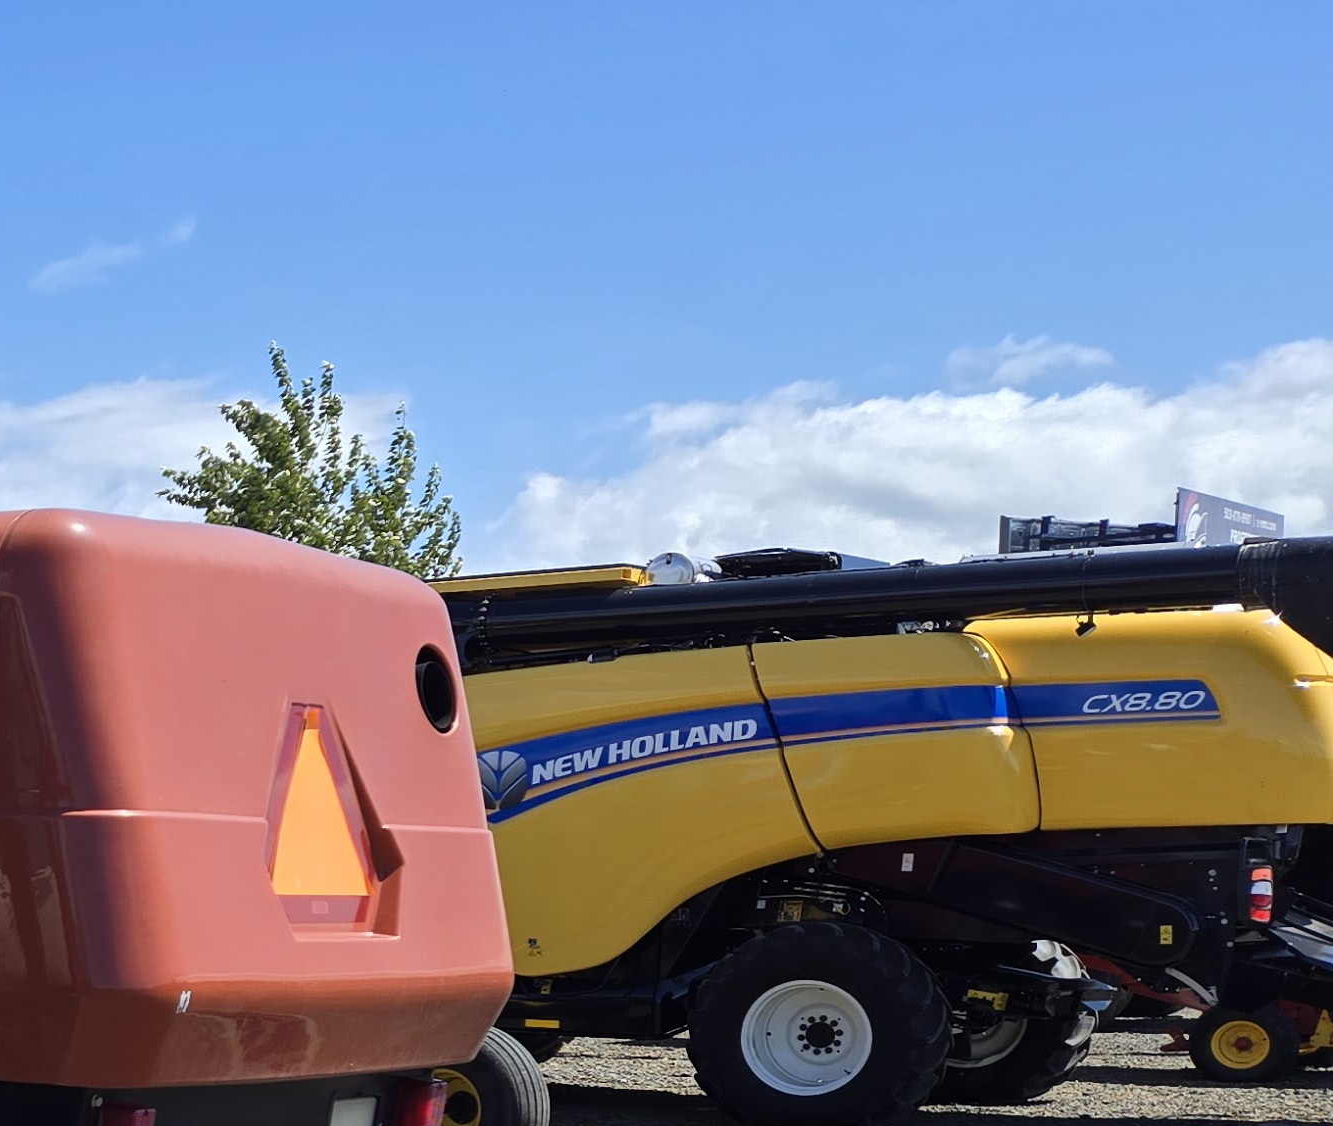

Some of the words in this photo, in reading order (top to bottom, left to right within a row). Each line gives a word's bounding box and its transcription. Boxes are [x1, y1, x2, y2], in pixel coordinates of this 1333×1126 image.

[1082, 690, 1206, 714] CX8.80
[531, 746, 604, 785] NEW
[608, 719, 758, 764] HOLLAND
